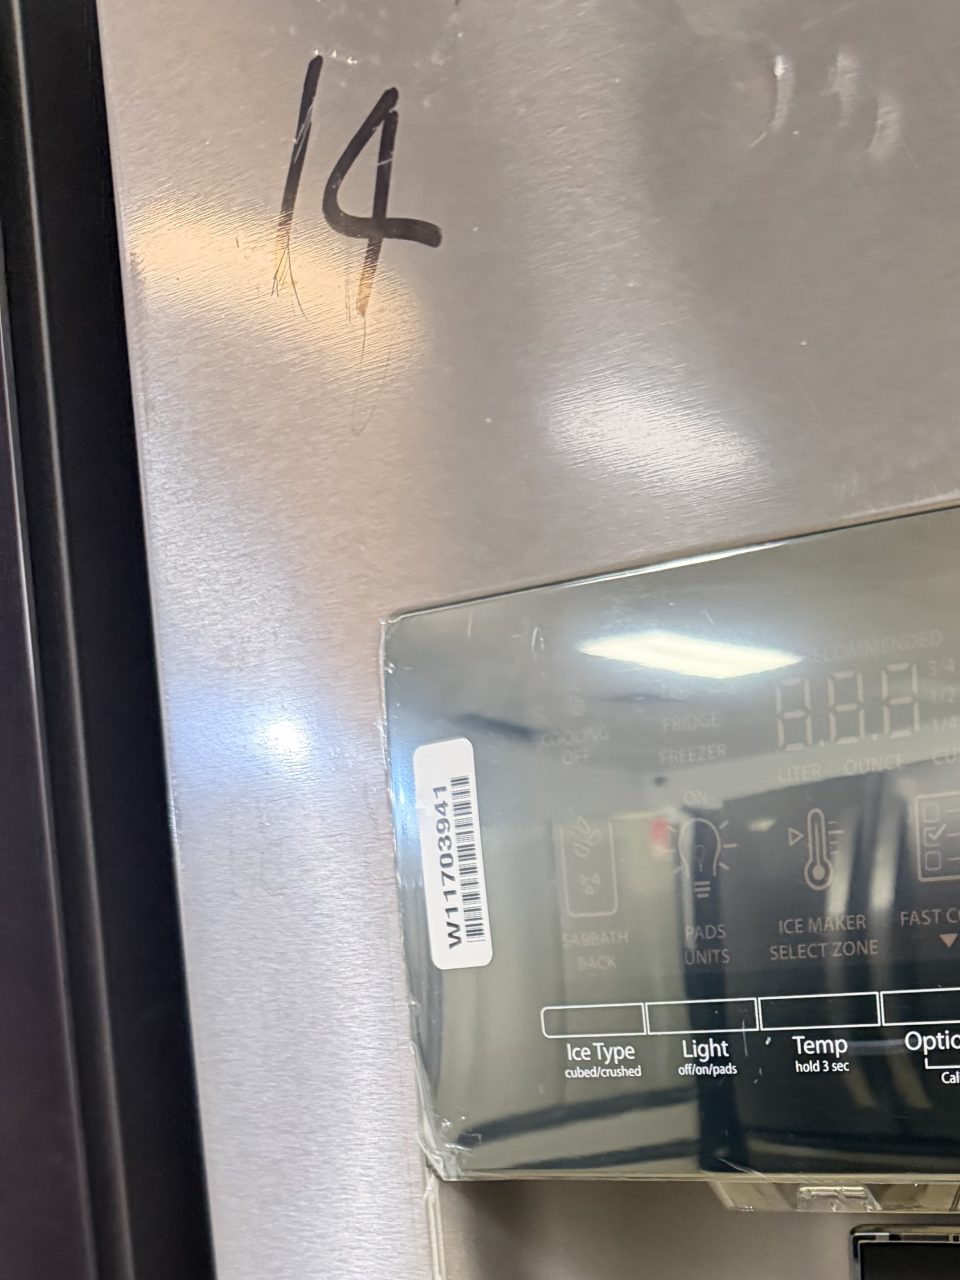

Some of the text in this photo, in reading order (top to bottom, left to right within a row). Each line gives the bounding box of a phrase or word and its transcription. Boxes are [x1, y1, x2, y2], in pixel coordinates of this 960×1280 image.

[272, 54, 443, 317] 14
[661, 710, 719, 732] FRIDGE
[539, 724, 611, 749] COOLING
[560, 748, 592, 766] OFF
[657, 742, 727, 765] FREEZER
[777, 762, 823, 784] LITER
[843, 752, 905, 776] OUNCE
[433, 784, 461, 950] W11703941
[778, 914, 868, 935] ICE MAKER
[900, 908, 942, 926] FAST
[562, 930, 630, 949] SABBATH
[685, 924, 728, 941] PADS
[684, 948, 731, 966] UNITS
[769, 939, 879, 961] SELECT ZONE
[576, 955, 617, 971] BACK
[566, 1041, 636, 1065] Ice Type
[682, 1037, 730, 1062] Light
[792, 1034, 849, 1055] Temp
[564, 1064, 642, 1079] cubed/crushed
[677, 1062, 738, 1077] off/on/pads
[795, 1060, 850, 1074] hold 3 sec
